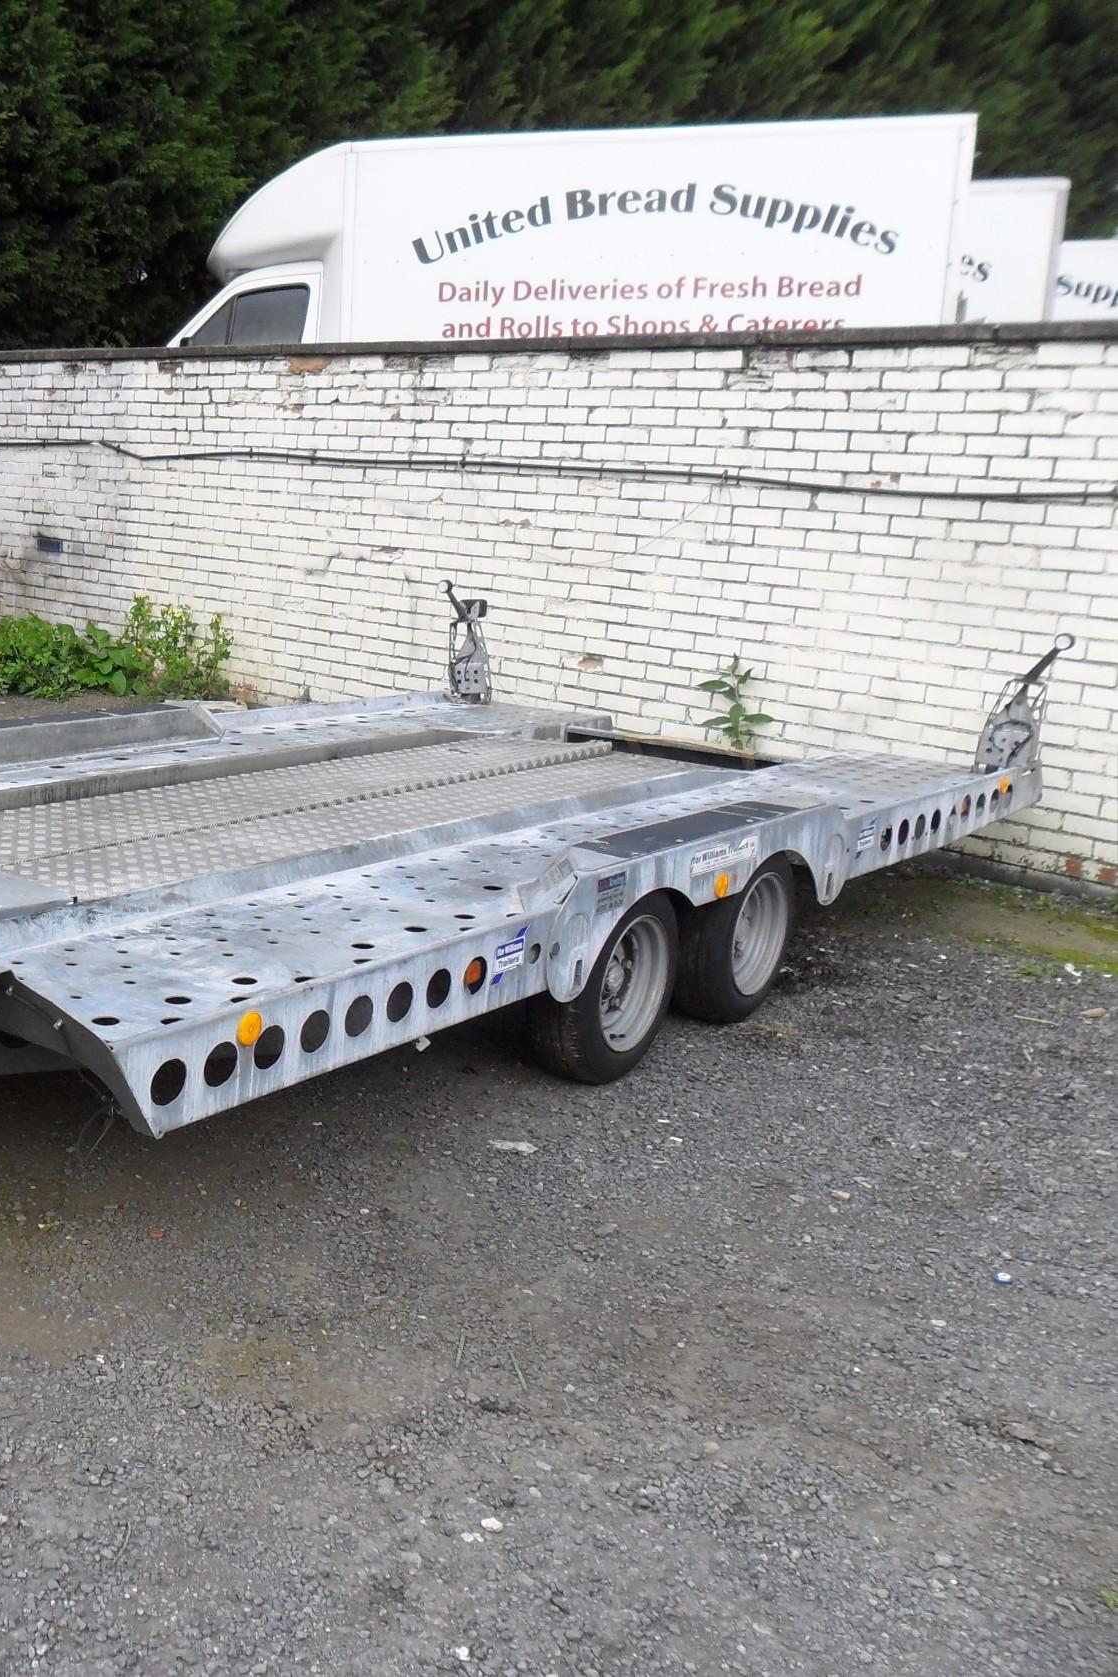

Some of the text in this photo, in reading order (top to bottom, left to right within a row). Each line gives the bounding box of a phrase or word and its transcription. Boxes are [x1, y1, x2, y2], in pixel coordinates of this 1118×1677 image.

[412, 183, 900, 264] United Bread Supplies
[438, 274, 863, 307] Daily Deliveries of Fresh Bread
[441, 316, 492, 339] and
[500, 315, 563, 338] Rolls
[571, 318, 599, 337] to
[607, 315, 690, 335] Shops
[698, 314, 718, 333] &
